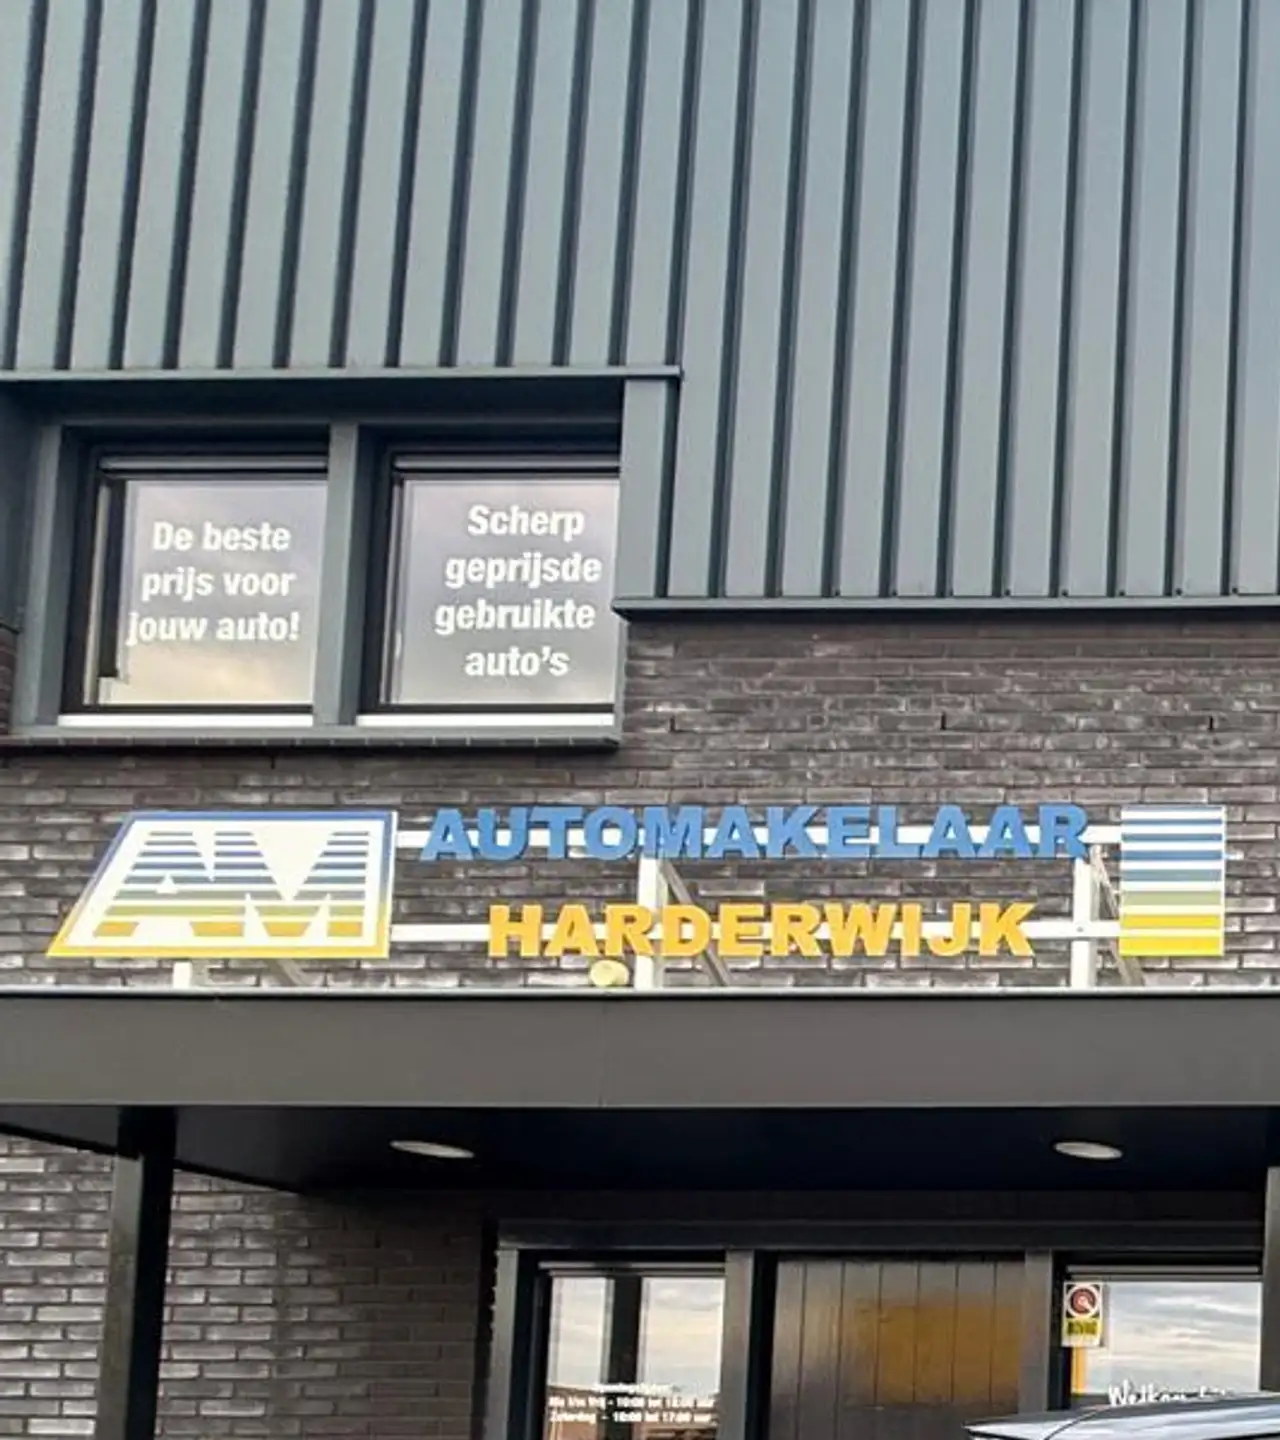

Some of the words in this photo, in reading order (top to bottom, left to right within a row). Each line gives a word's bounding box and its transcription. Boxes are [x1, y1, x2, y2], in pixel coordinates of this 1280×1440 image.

[152, 521, 194, 552] De
[203, 521, 290, 552] beste
[467, 505, 585, 537] Scherp
[141, 567, 213, 599] prijs
[224, 572, 296, 597] voor
[445, 552, 602, 585] geprijsde
[126, 612, 206, 645] jouw
[219, 611, 299, 641] auto!
[435, 599, 595, 636] gebruikte
[420, 803, 1090, 863] AUTOMAKELAAR
[93, 831, 370, 937] AM
[487, 903, 1036, 956] HARDERWIJK
